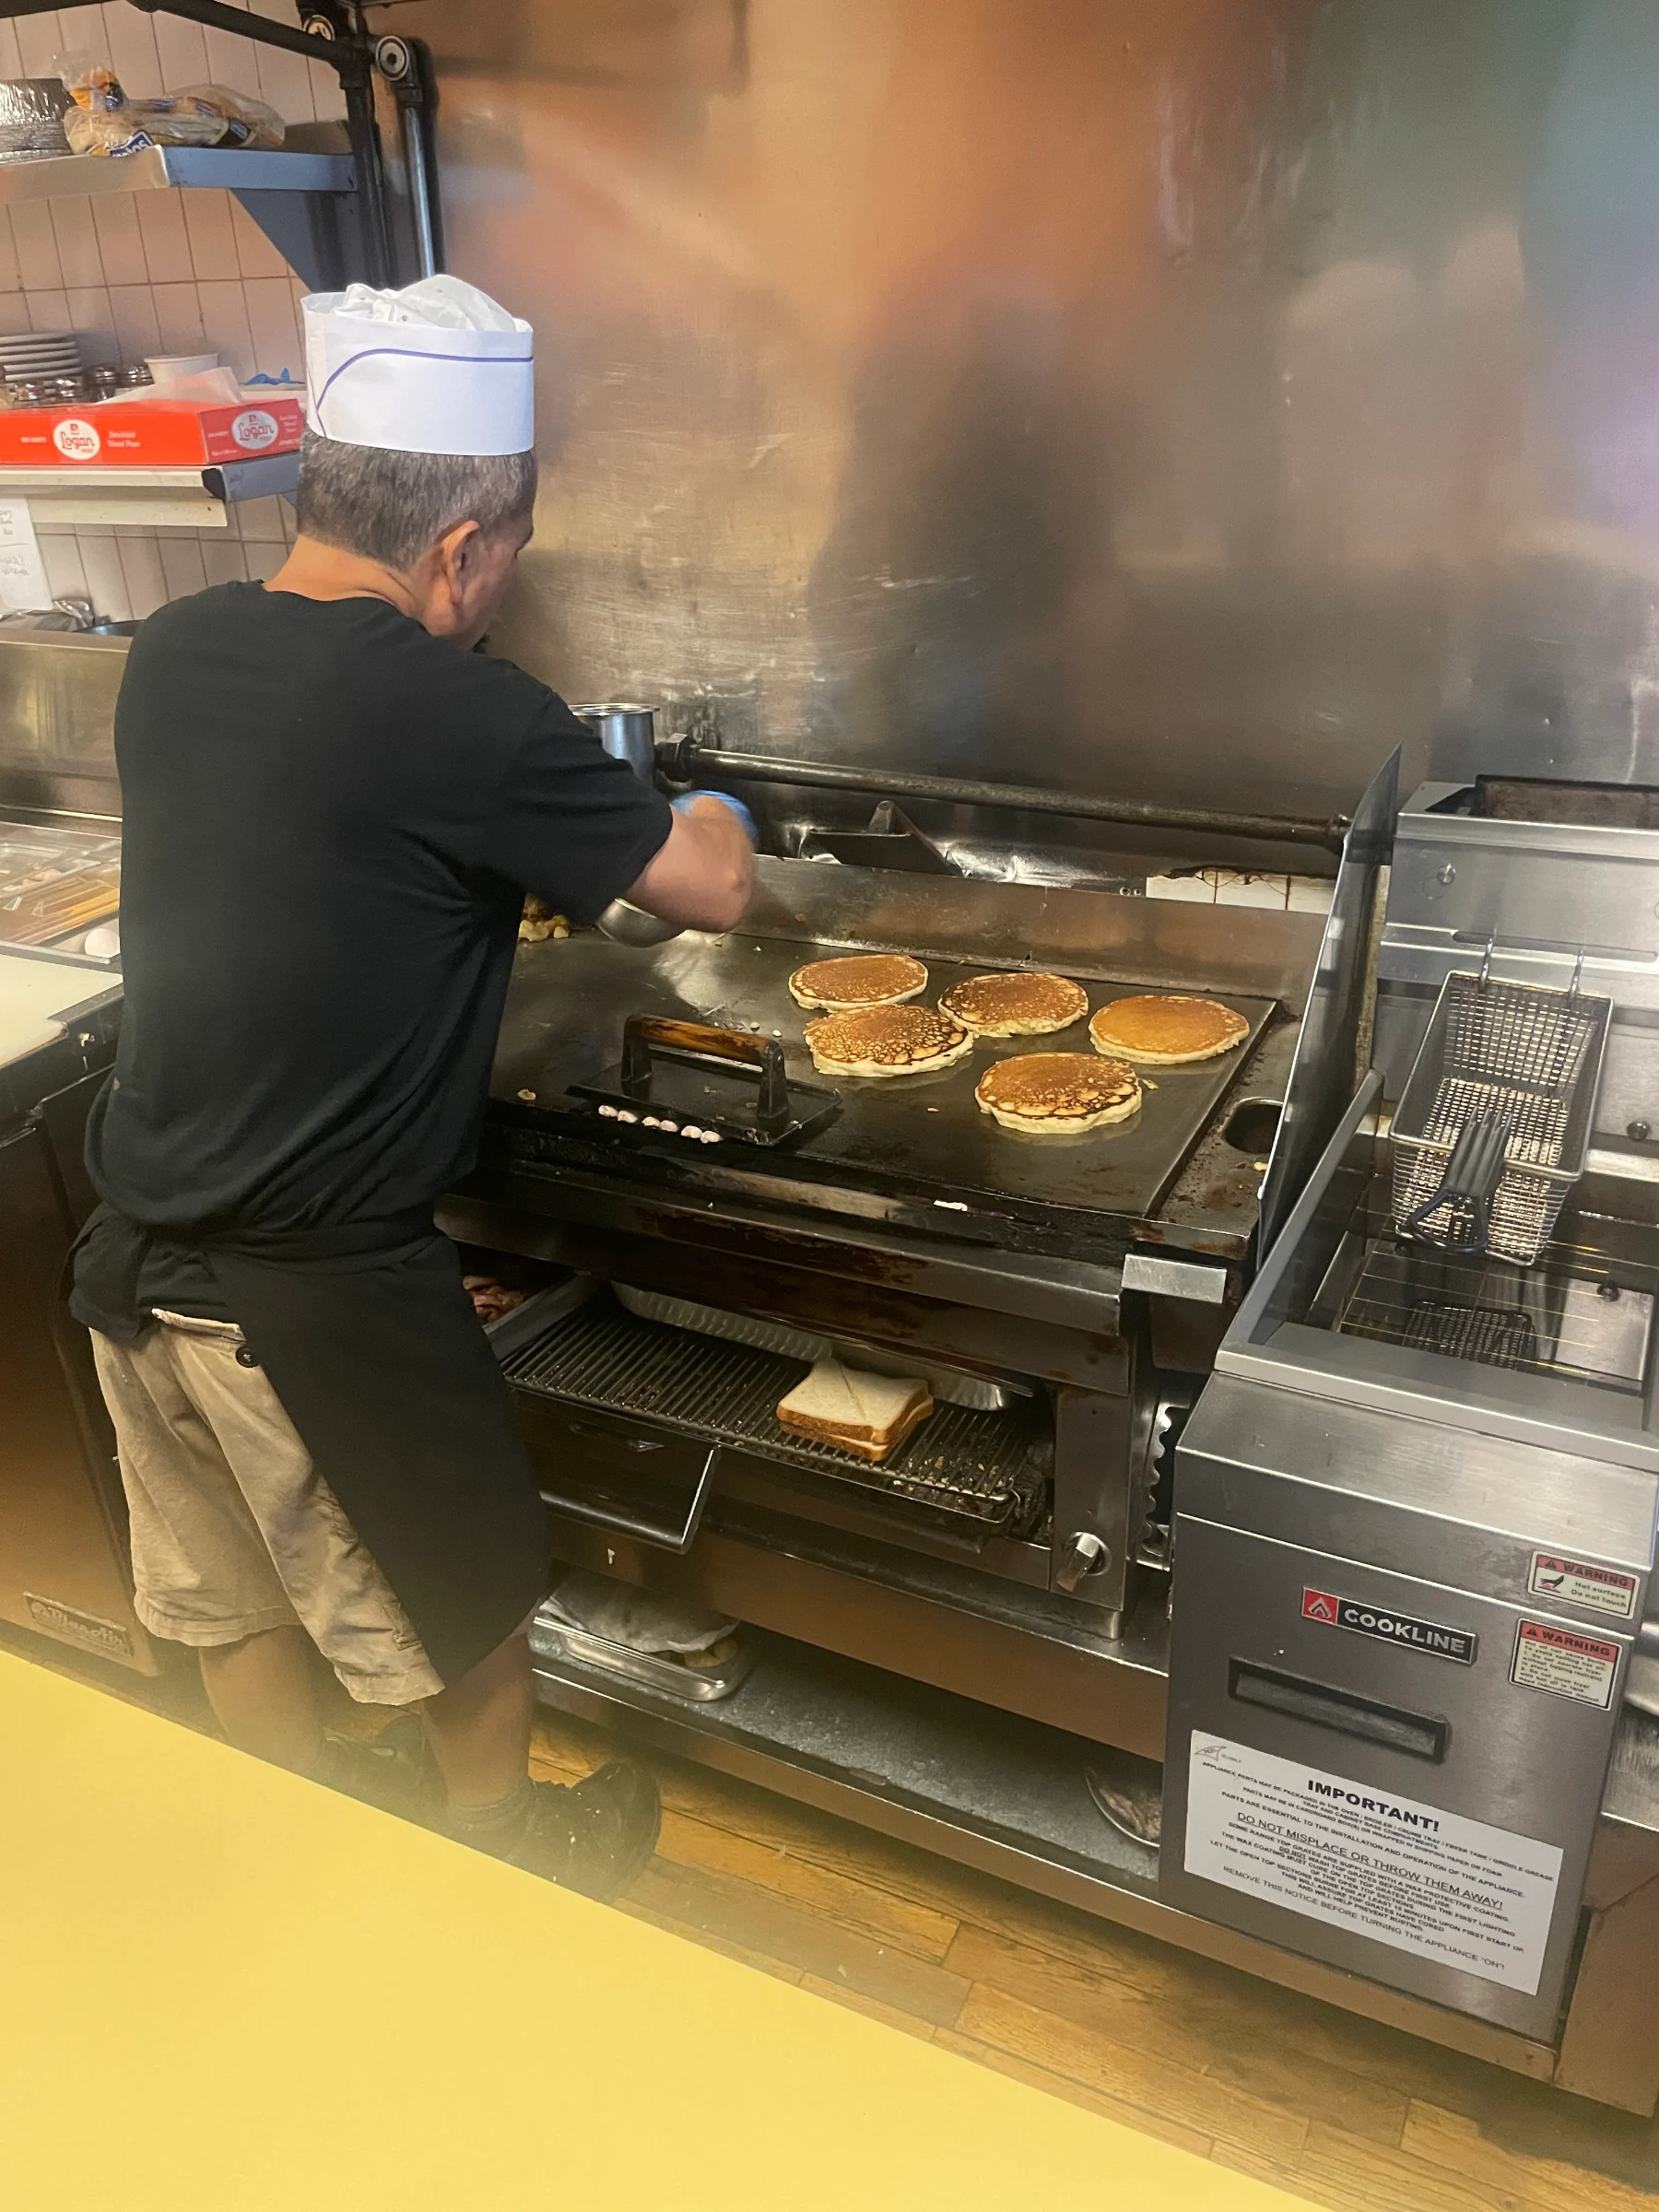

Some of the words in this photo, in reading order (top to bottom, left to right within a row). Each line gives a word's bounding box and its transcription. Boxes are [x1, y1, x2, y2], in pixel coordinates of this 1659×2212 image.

[60, 431, 95, 450] Logan
[238, 422, 275, 441] Logan
[1563, 1563, 1628, 1586] WARNING
[1603, 1597, 1626, 1607] touch
[1344, 1607, 1465, 1653] COOKLINE
[1542, 1631, 1610, 1655] WARNING
[1308, 1779, 1439, 1832] IMPORTANT!
[1238, 1812, 1254, 1825] DO
[1258, 1818, 1282, 1834] NOT
[1287, 1829, 1347, 1856] MISPLACE
[1351, 1851, 1369, 1864] OR
[1374, 1859, 1419, 1881] THROW
[1425, 1877, 1459, 1895] THEM
[1463, 1888, 1502, 1910] AWAY!
